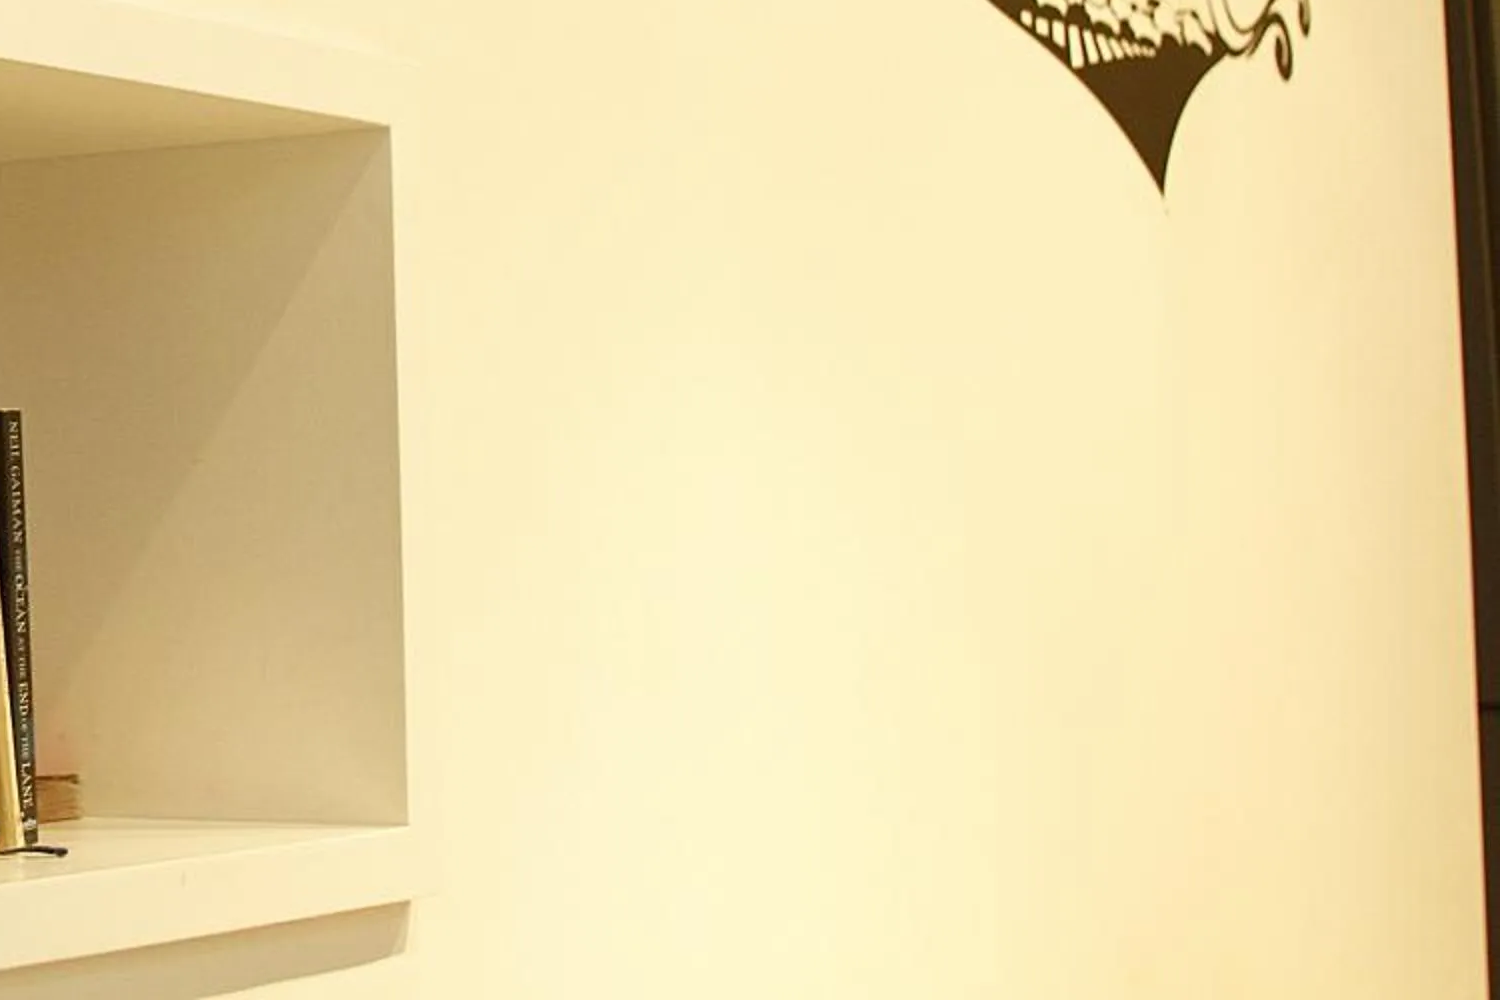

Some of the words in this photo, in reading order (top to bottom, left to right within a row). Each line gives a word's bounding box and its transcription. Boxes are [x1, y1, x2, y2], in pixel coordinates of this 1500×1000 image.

[7, 420, 20, 458] NEIL
[10, 464, 24, 544] GAIMAN
[14, 575, 27, 634] OCEAN
[17, 680, 31, 714] END
[20, 761, 34, 807] LANE
